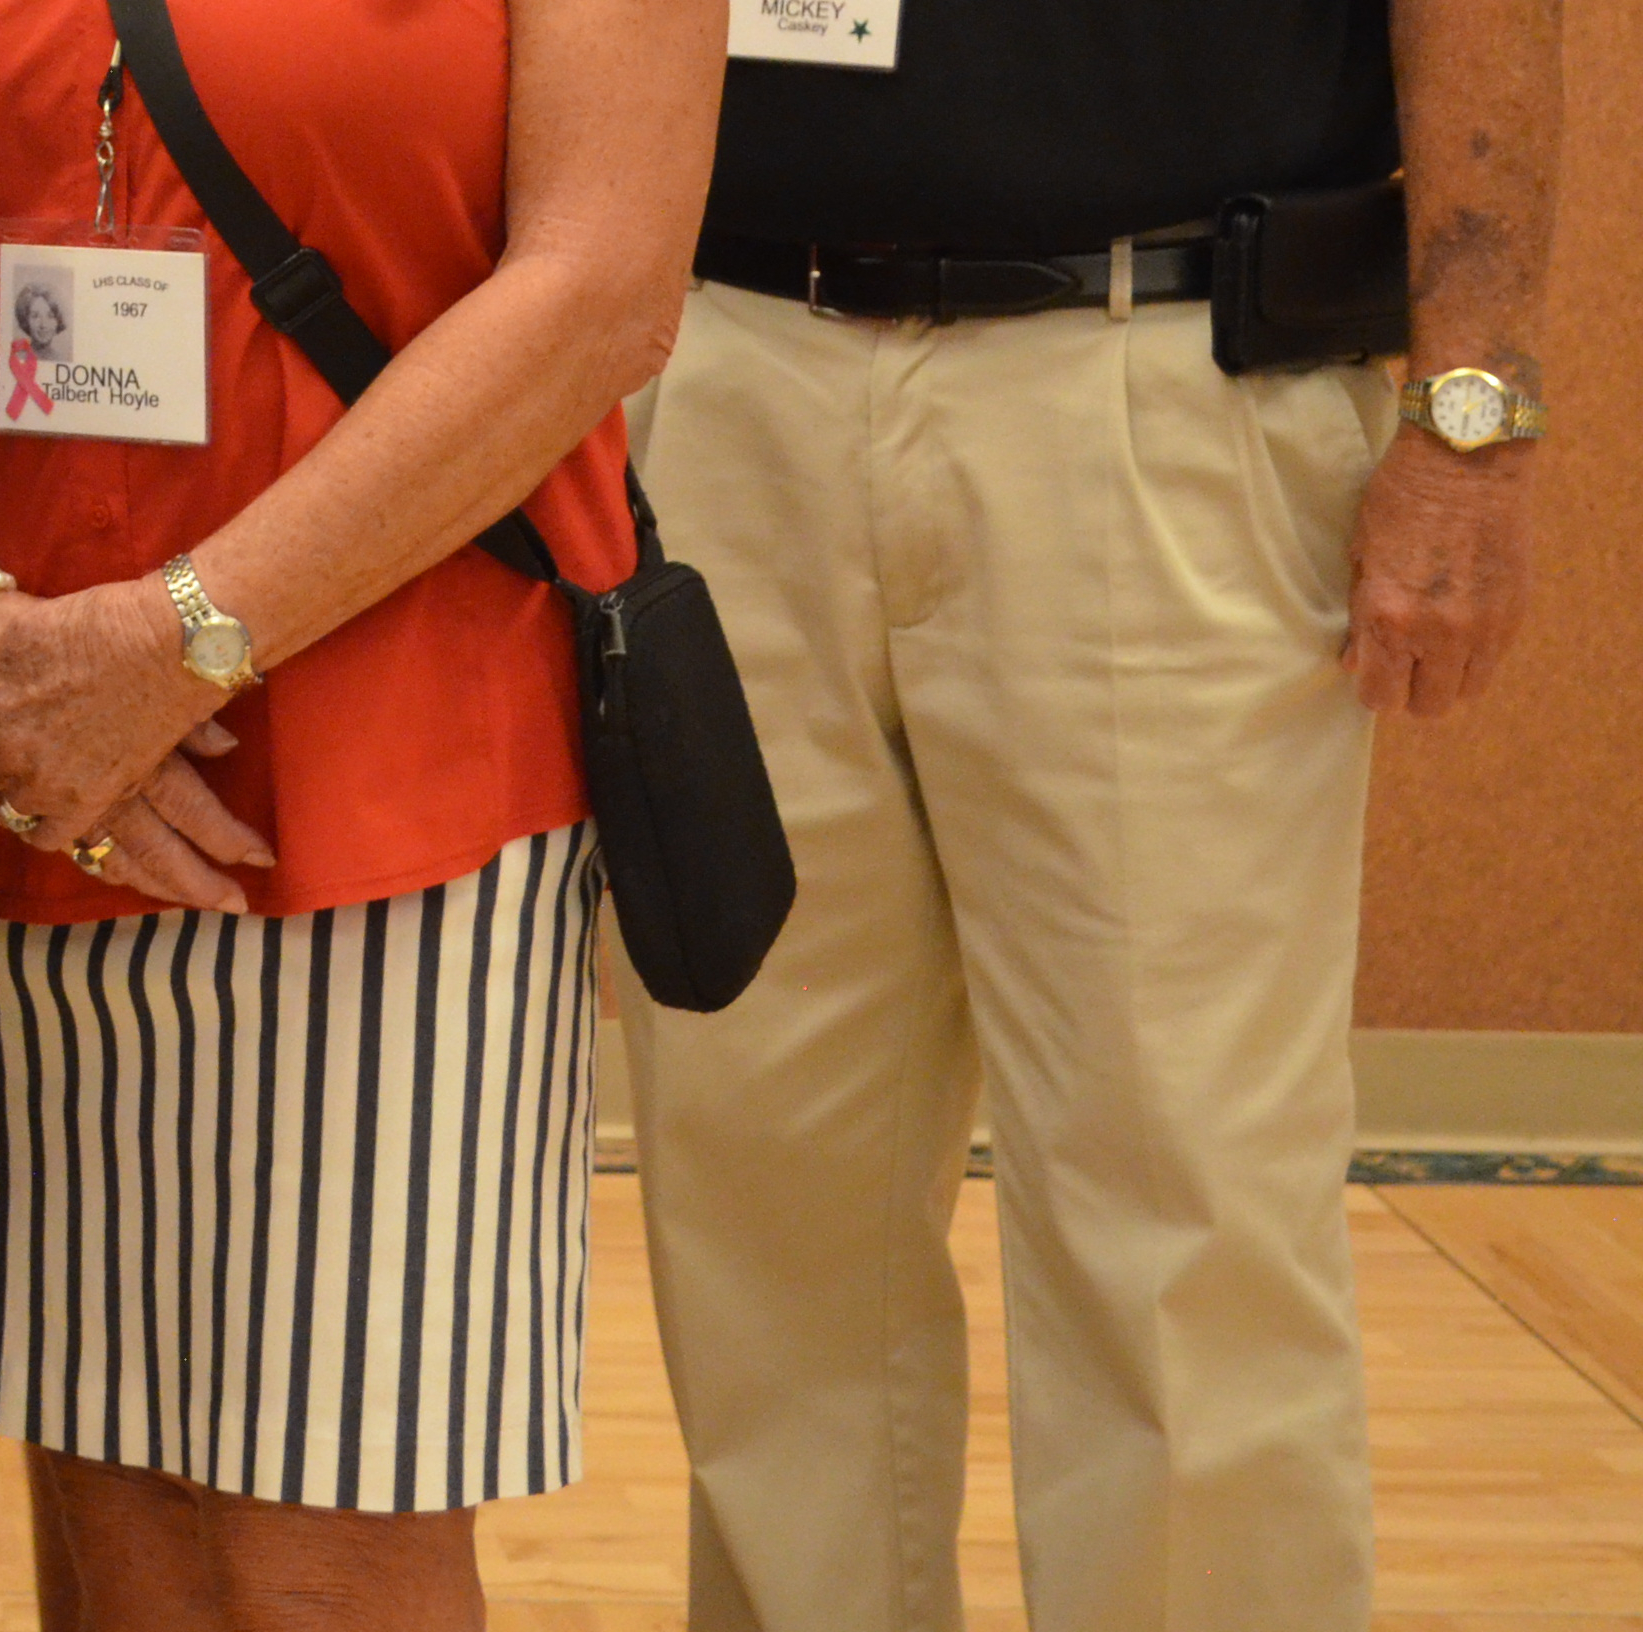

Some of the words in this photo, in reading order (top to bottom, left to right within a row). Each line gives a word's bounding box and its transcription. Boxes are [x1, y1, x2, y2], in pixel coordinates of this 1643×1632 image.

[777, 18, 829, 36] Caskey
[92, 275, 115, 289] LHS
[116, 274, 151, 289] CLASS
[111, 300, 149, 318] 1967
[54, 363, 141, 390] DONNA
[41, 382, 99, 405] Talbert
[109, 384, 160, 411] Hoyle
